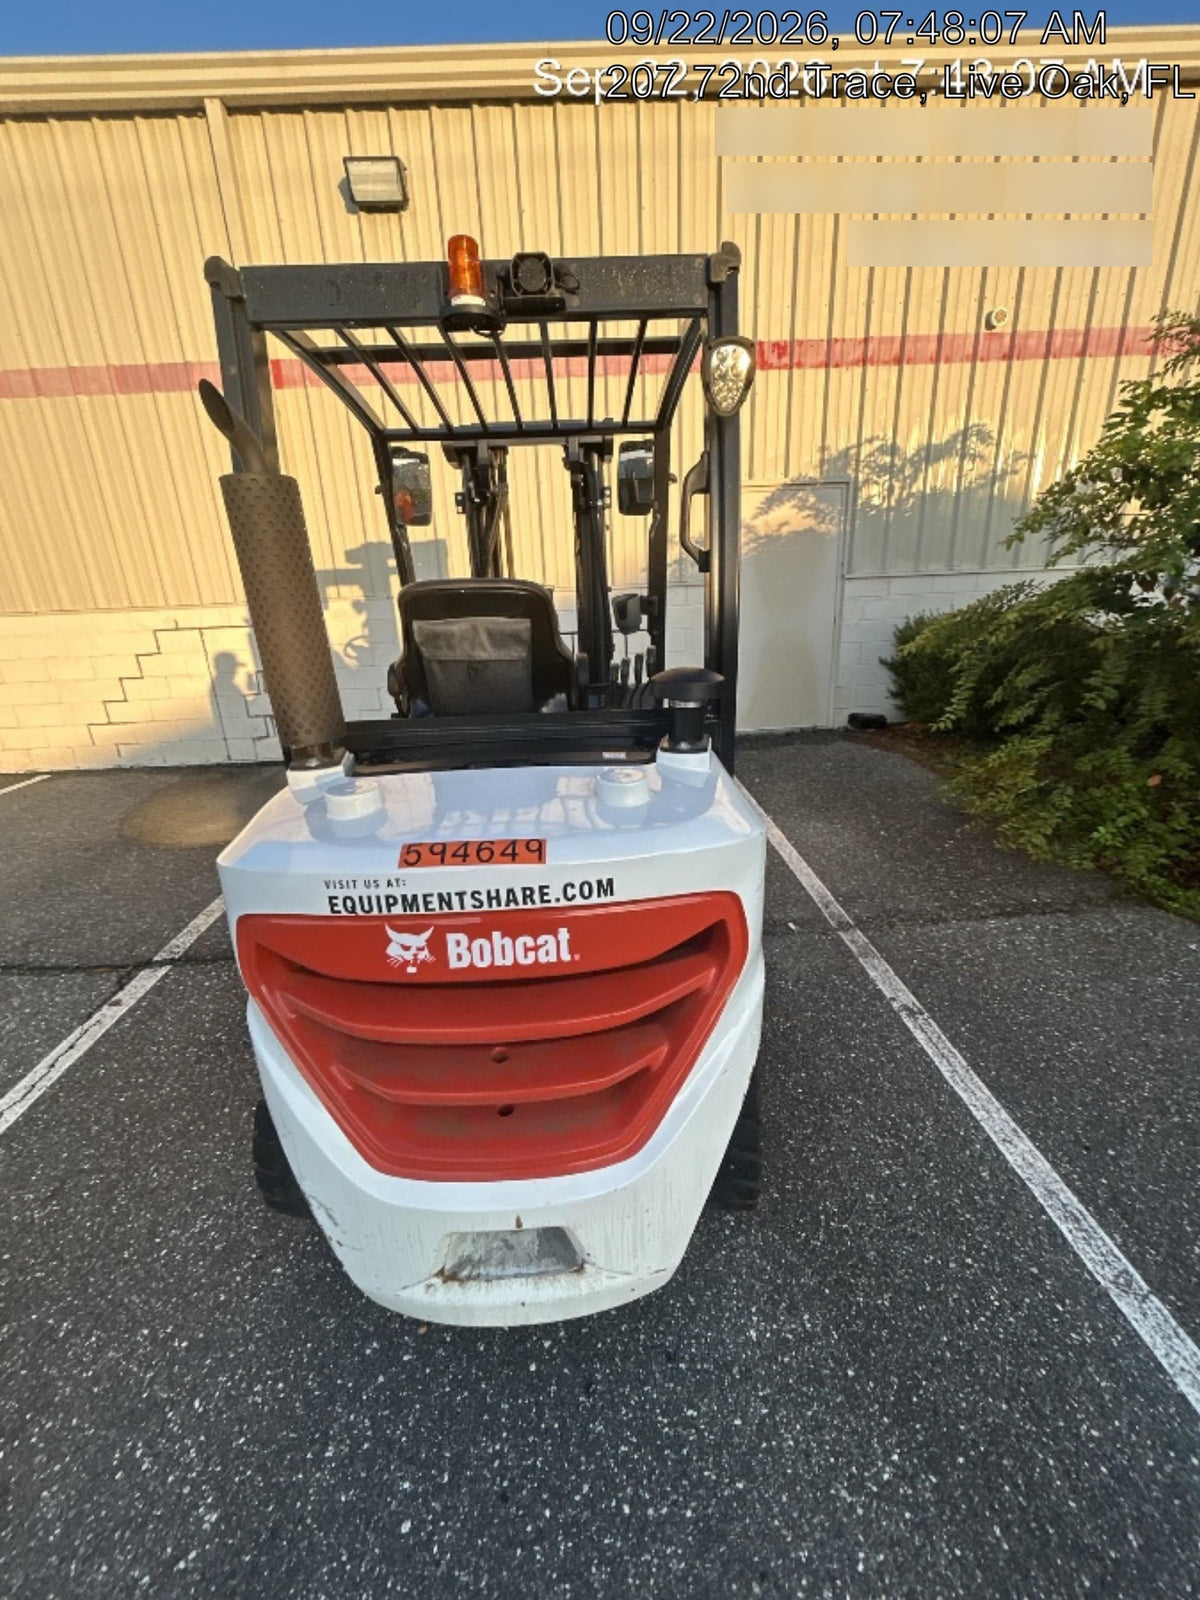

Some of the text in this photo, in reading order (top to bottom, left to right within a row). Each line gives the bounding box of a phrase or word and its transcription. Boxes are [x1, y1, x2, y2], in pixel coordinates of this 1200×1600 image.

[402, 839, 544, 866] 594649
[324, 878, 407, 889] VISIT US AT:
[328, 878, 615, 915] EQUIPMENTSHARE.COM
[446, 927, 572, 969] Bobcat
